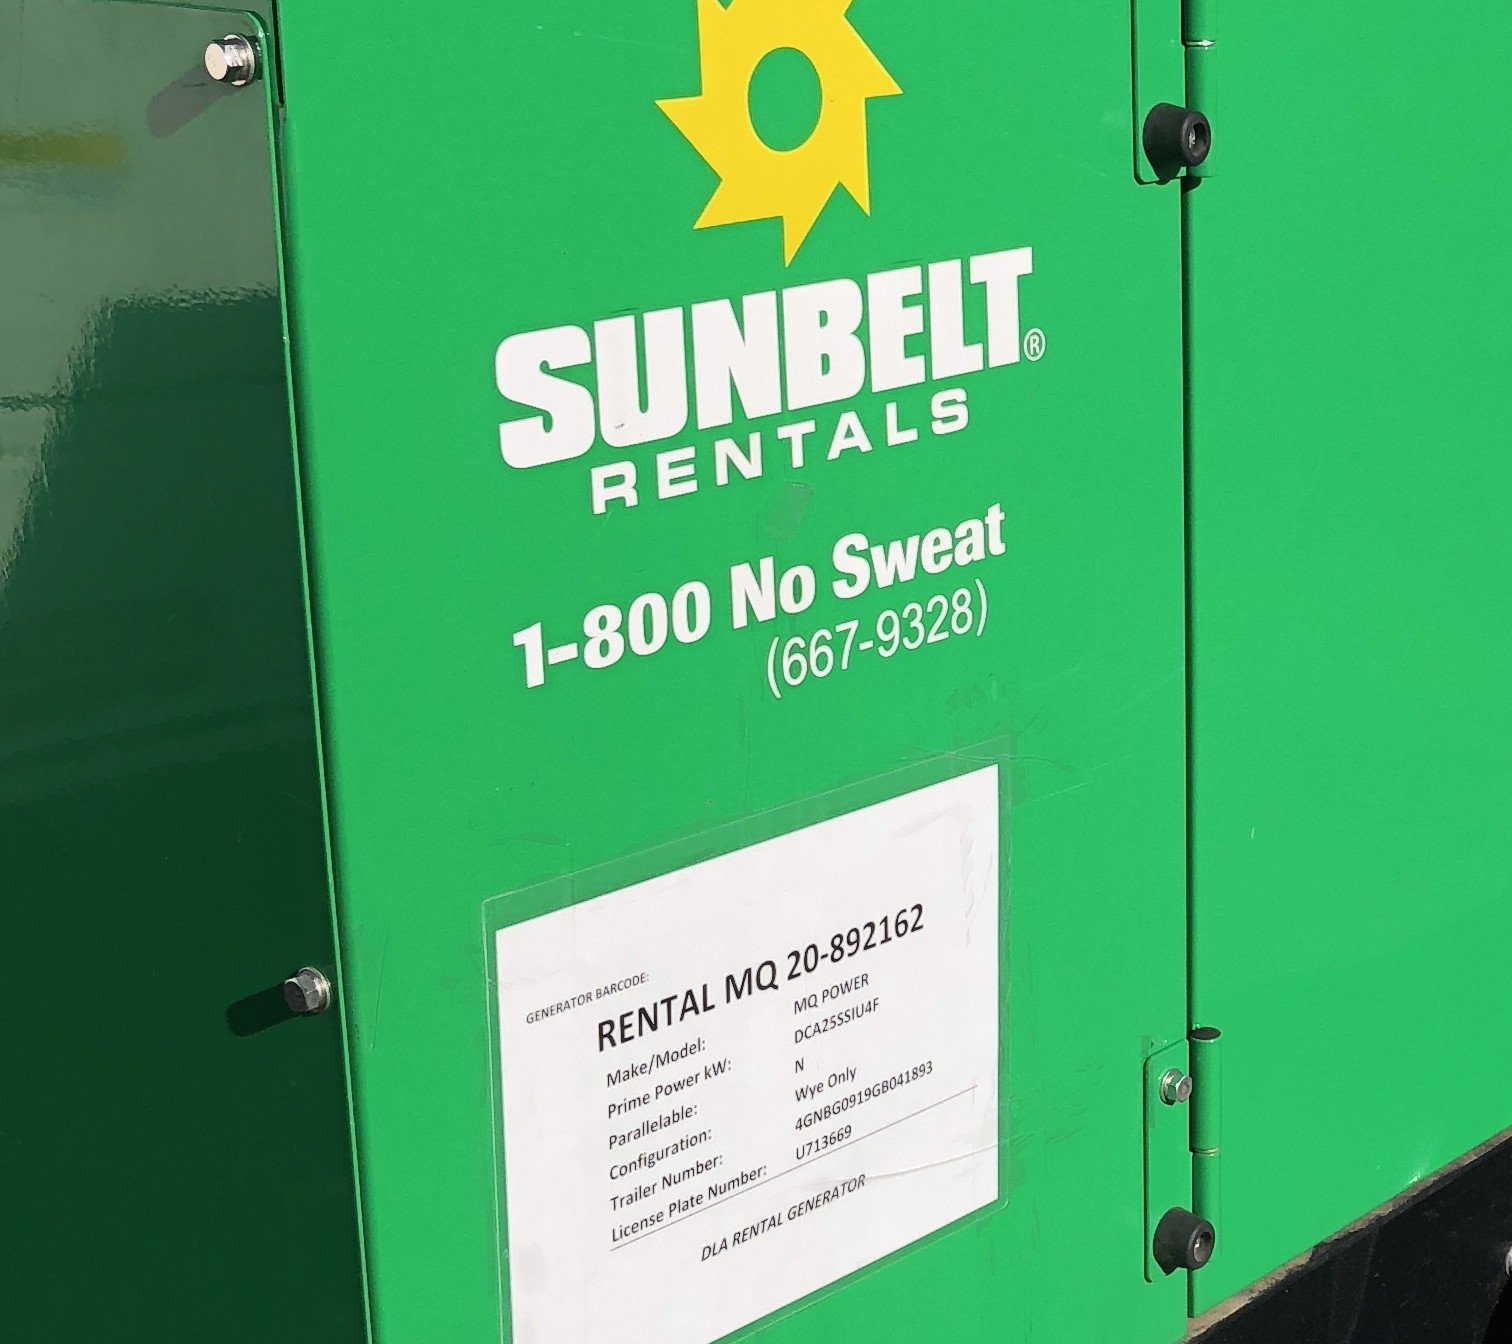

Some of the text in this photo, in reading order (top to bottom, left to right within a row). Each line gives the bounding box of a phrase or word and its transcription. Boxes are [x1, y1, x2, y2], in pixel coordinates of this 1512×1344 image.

[590, 387, 971, 516] RENTALS
[511, 502, 1007, 690] 1-800 No Sweat
[765, 578, 988, 700] (667-9328)
[526, 971, 650, 1025] GENERATOR BARCODE:
[597, 903, 924, 1052] RENTAL MQ 20-892162
[606, 972, 870, 1088] Make/Model: MQ POWER
[607, 997, 880, 1119] Prime Power kW: DCA25SSIU4F
[608, 1057, 805, 1150] Parallelable: N
[609, 1065, 857, 1181] Configuration: Wye Only
[610, 1179, 658, 1212] Trailer
[661, 1153, 724, 1192] Number:
[611, 1124, 853, 1243] License Plate Number: U713669
[700, 1172, 867, 1262] DLA RENTAL GENERATOR
